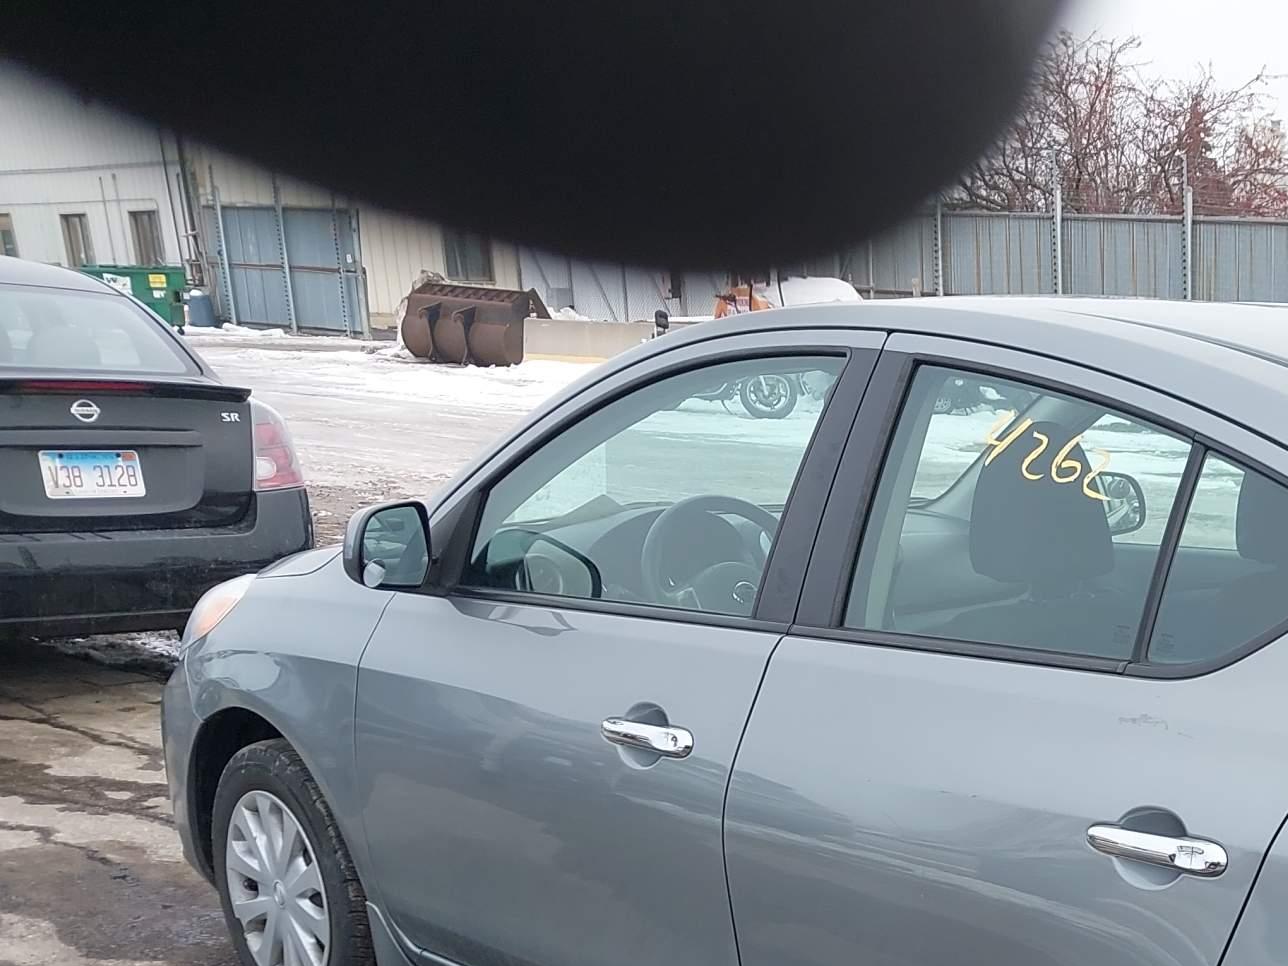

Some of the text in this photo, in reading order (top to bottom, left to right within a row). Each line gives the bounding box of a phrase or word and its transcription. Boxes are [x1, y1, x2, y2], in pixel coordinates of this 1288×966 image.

[221, 412, 241, 422] SR
[984, 408, 1113, 501] 4262
[48, 464, 138, 489] V38 3128
